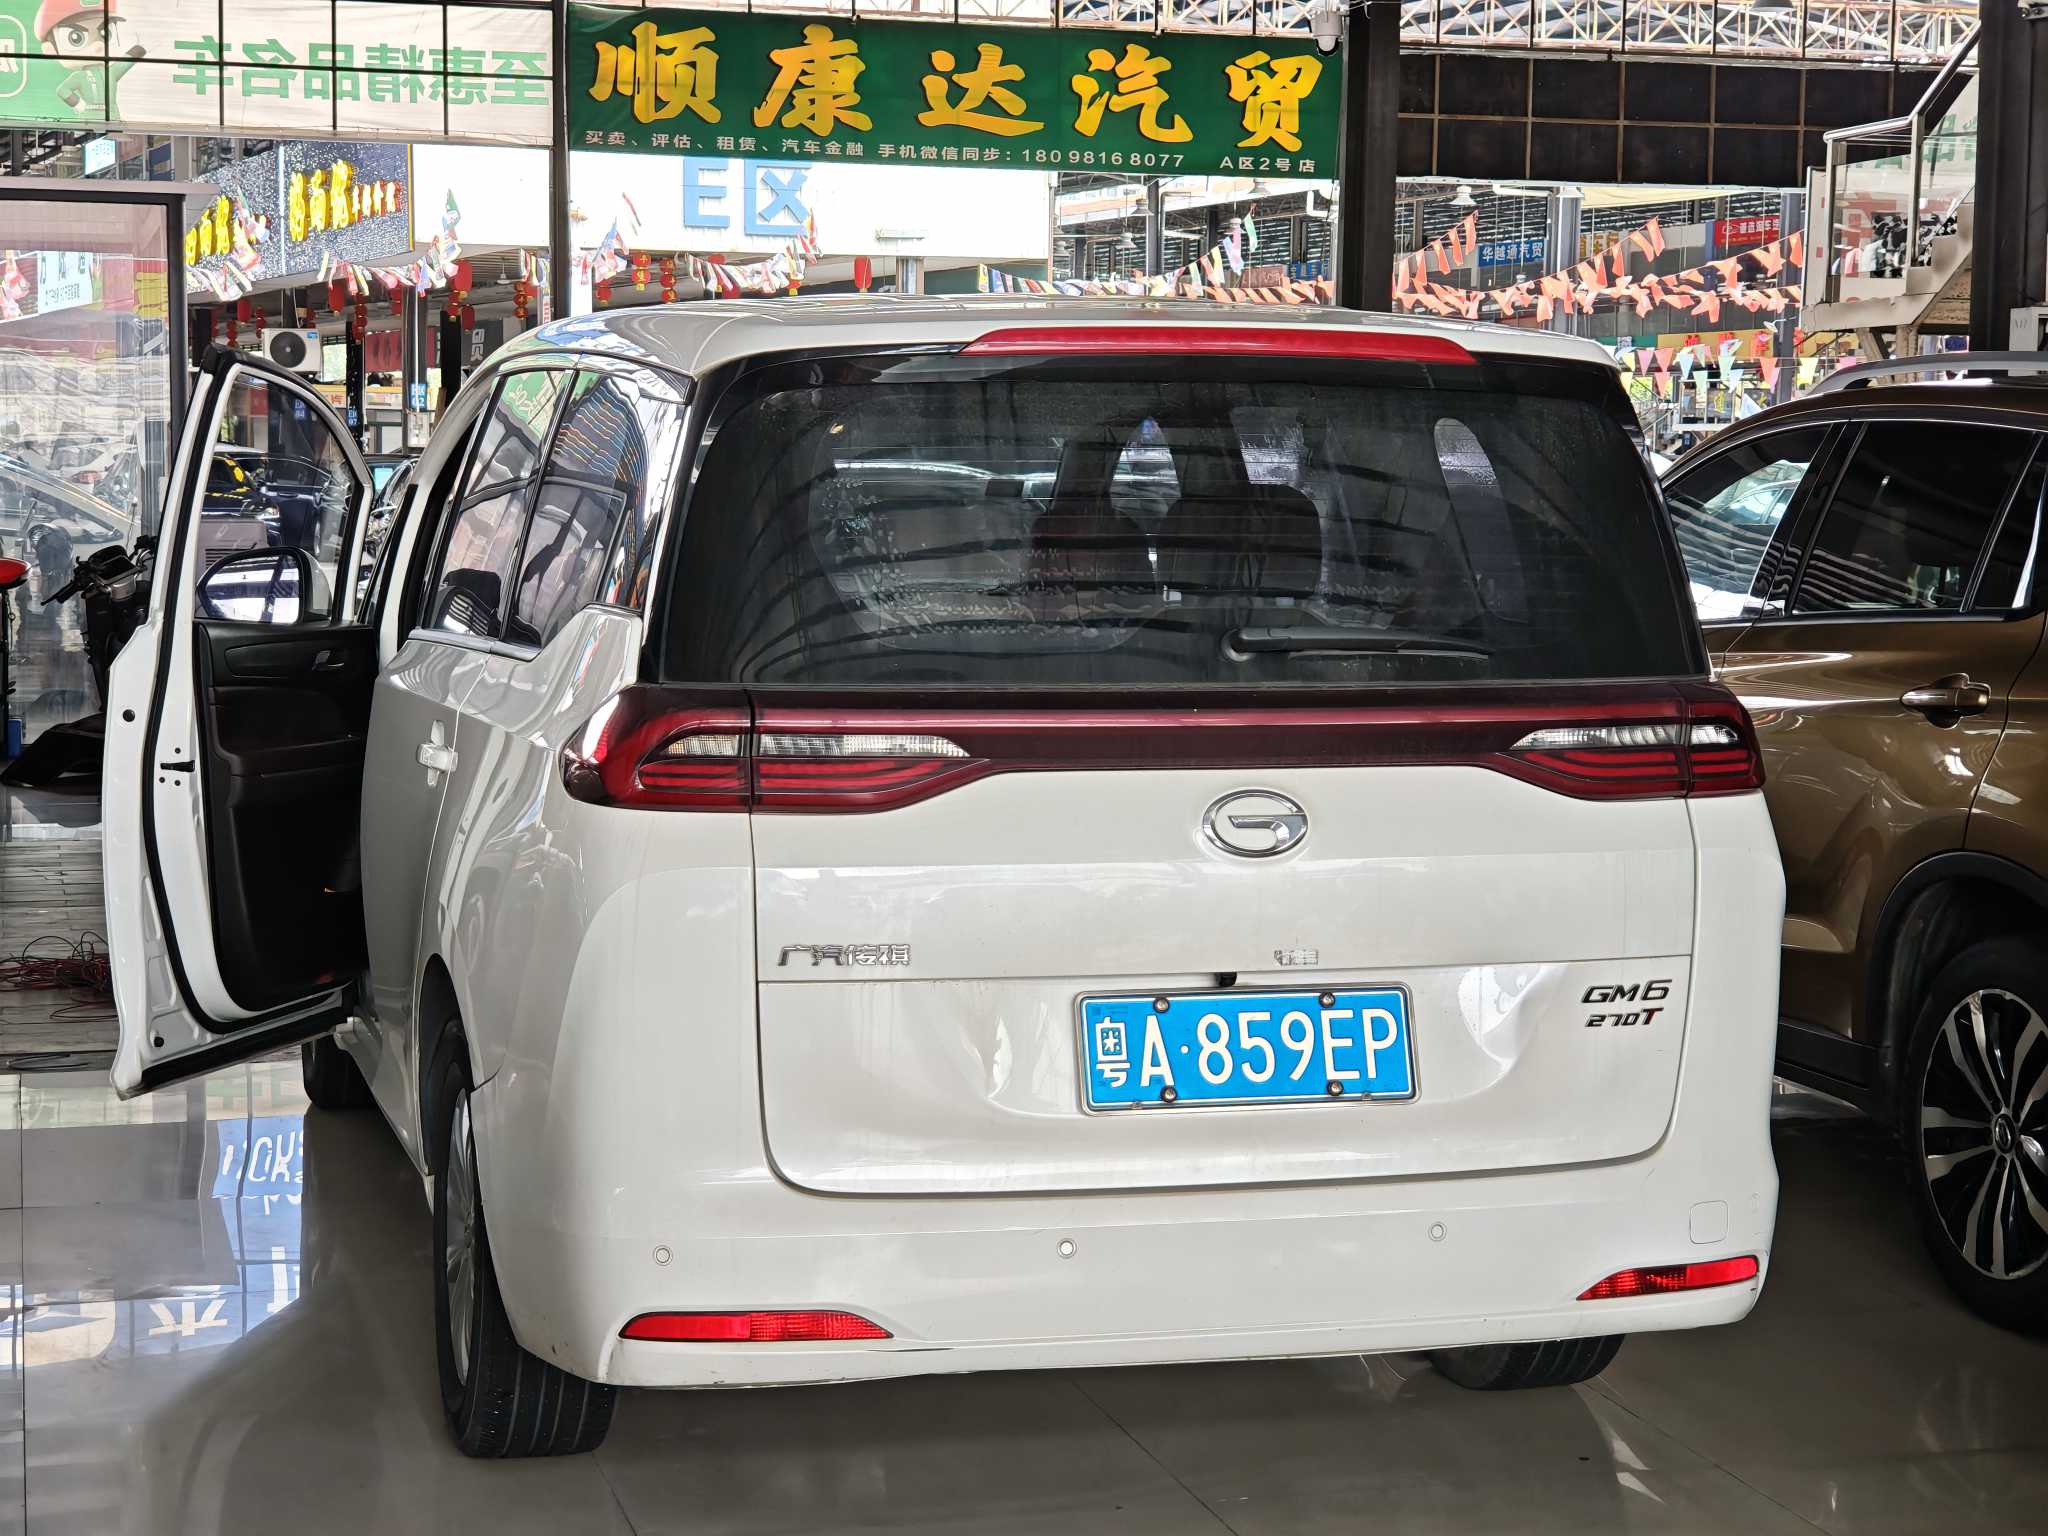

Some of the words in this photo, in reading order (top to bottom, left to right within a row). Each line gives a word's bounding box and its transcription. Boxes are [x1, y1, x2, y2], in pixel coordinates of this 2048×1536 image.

[588, 20, 1323, 152] 顺康达汽贸
[1219, 156, 1316, 173] A区2号店
[682, 158, 812, 236] E区
[778, 944, 911, 967] 广汽传祺
[1581, 979, 1673, 1003] GM6
[1585, 1007, 1665, 1028] 270T
[1094, 1008, 1398, 1088] 粤A·859EP
